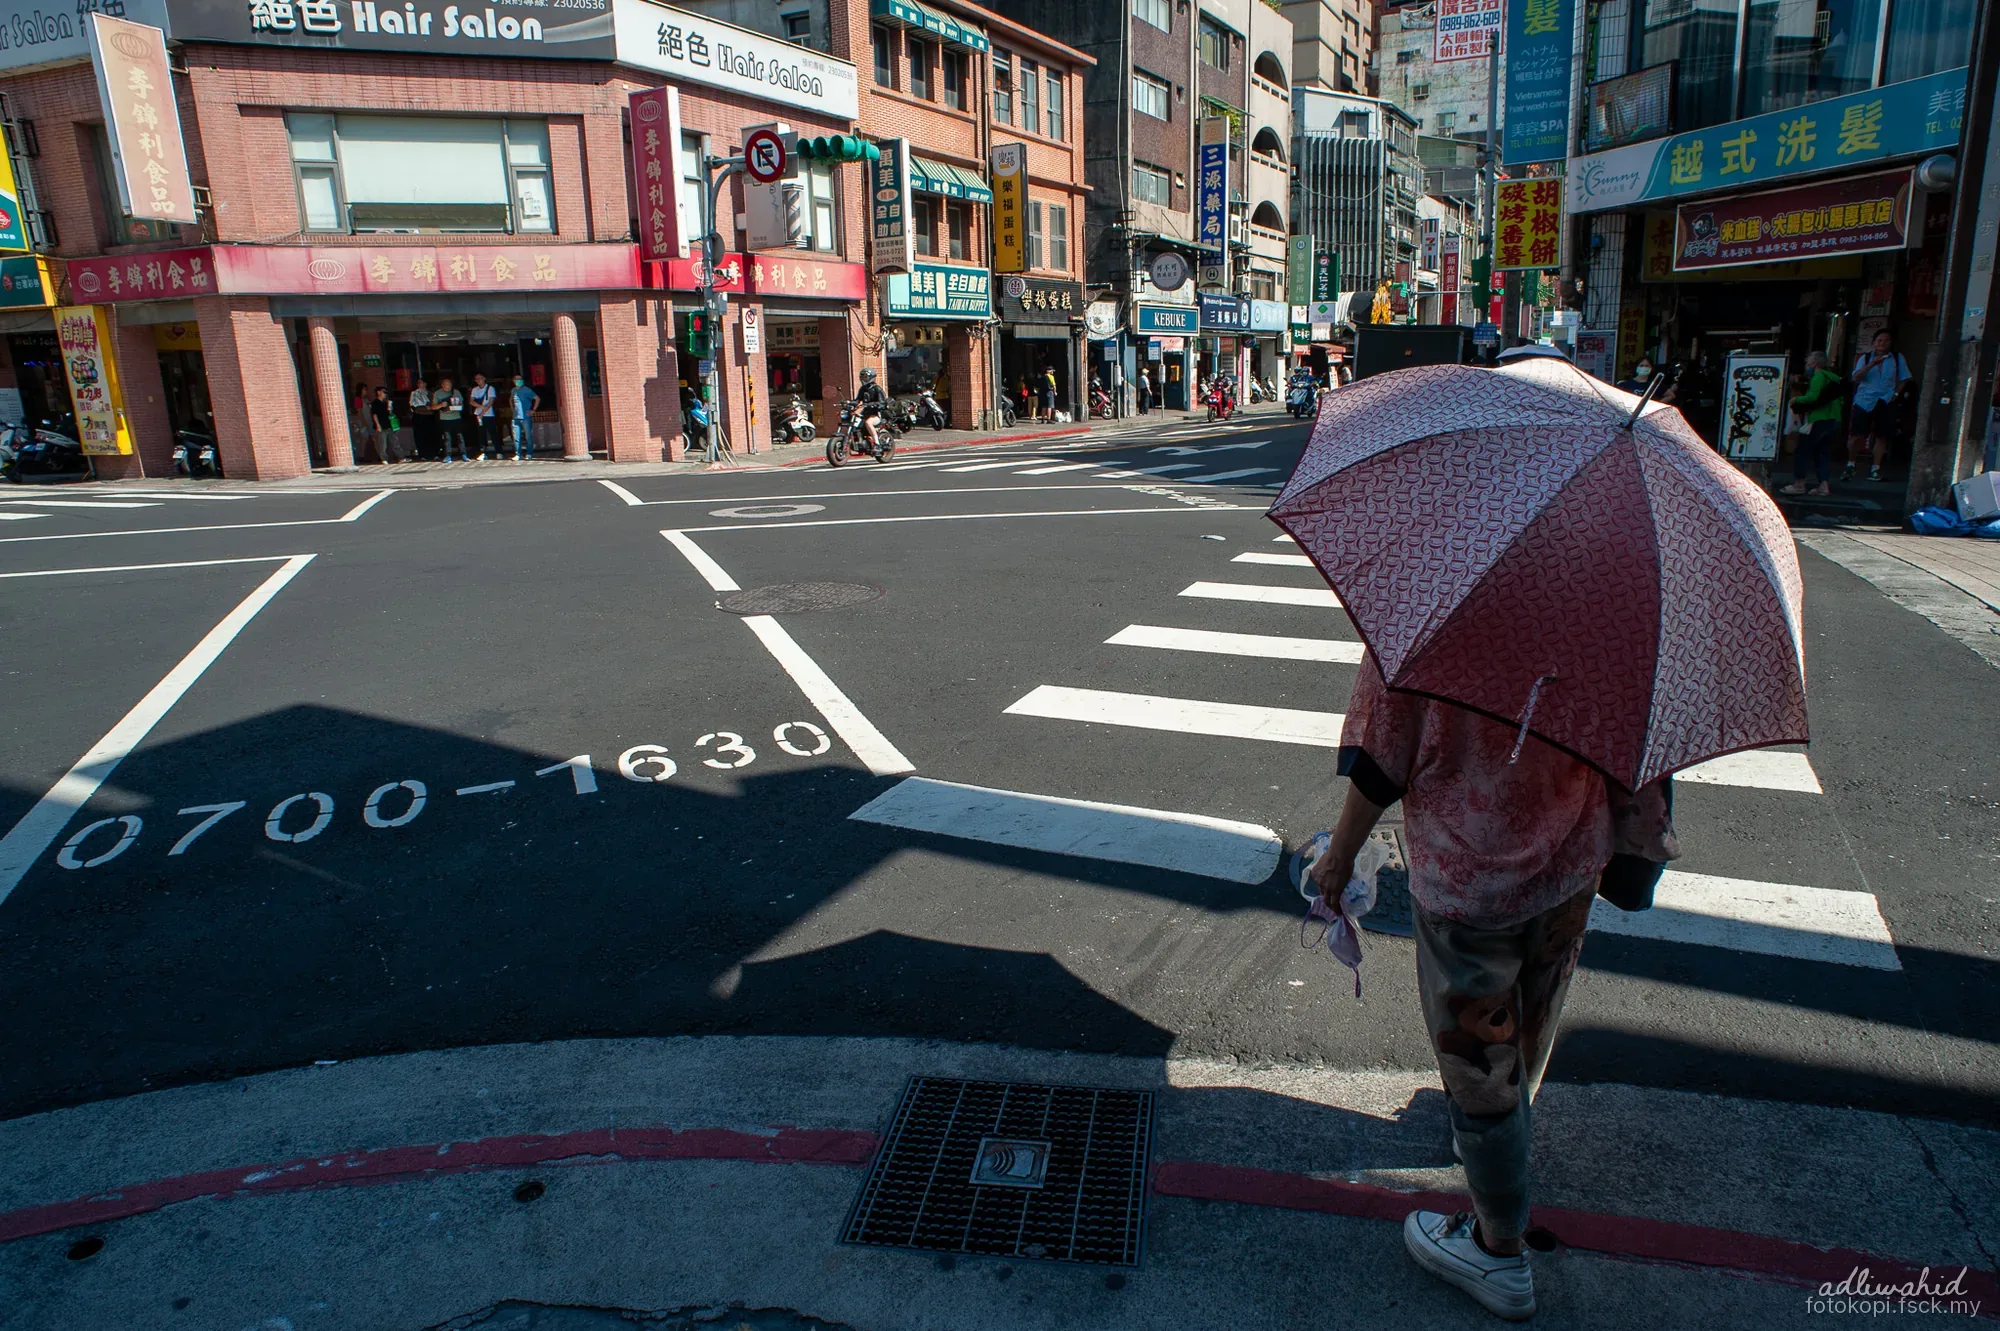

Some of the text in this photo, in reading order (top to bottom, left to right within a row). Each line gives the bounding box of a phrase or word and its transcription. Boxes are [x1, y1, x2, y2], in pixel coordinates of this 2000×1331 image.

[12, 10, 73, 47] Salon
[252, 0, 543, 41] 絕色 Hair Salon
[1440, 11, 1499, 31] 0989-862-609
[657, 22, 823, 97] 絕色 Hair Salon
[1509, 100, 1567, 114] hair wash care
[1515, 89, 1563, 100] Vietnamese
[1669, 99, 1884, 186] 越式洗髮
[878, 148, 895, 186] 萬美
[1592, 170, 1640, 190] Sunny
[1002, 180, 1015, 247] 樂福蛋糕
[1498, 182, 1529, 266] 碳烤番薯
[1528, 180, 1560, 264] 胡椒餅
[1839, 232, 1889, 244] 0982-104-866
[911, 270, 987, 293] 萬美 全自助餐
[1446, 256, 1456, 291] 新光銀行
[1154, 312, 1186, 327] KEBUKE
